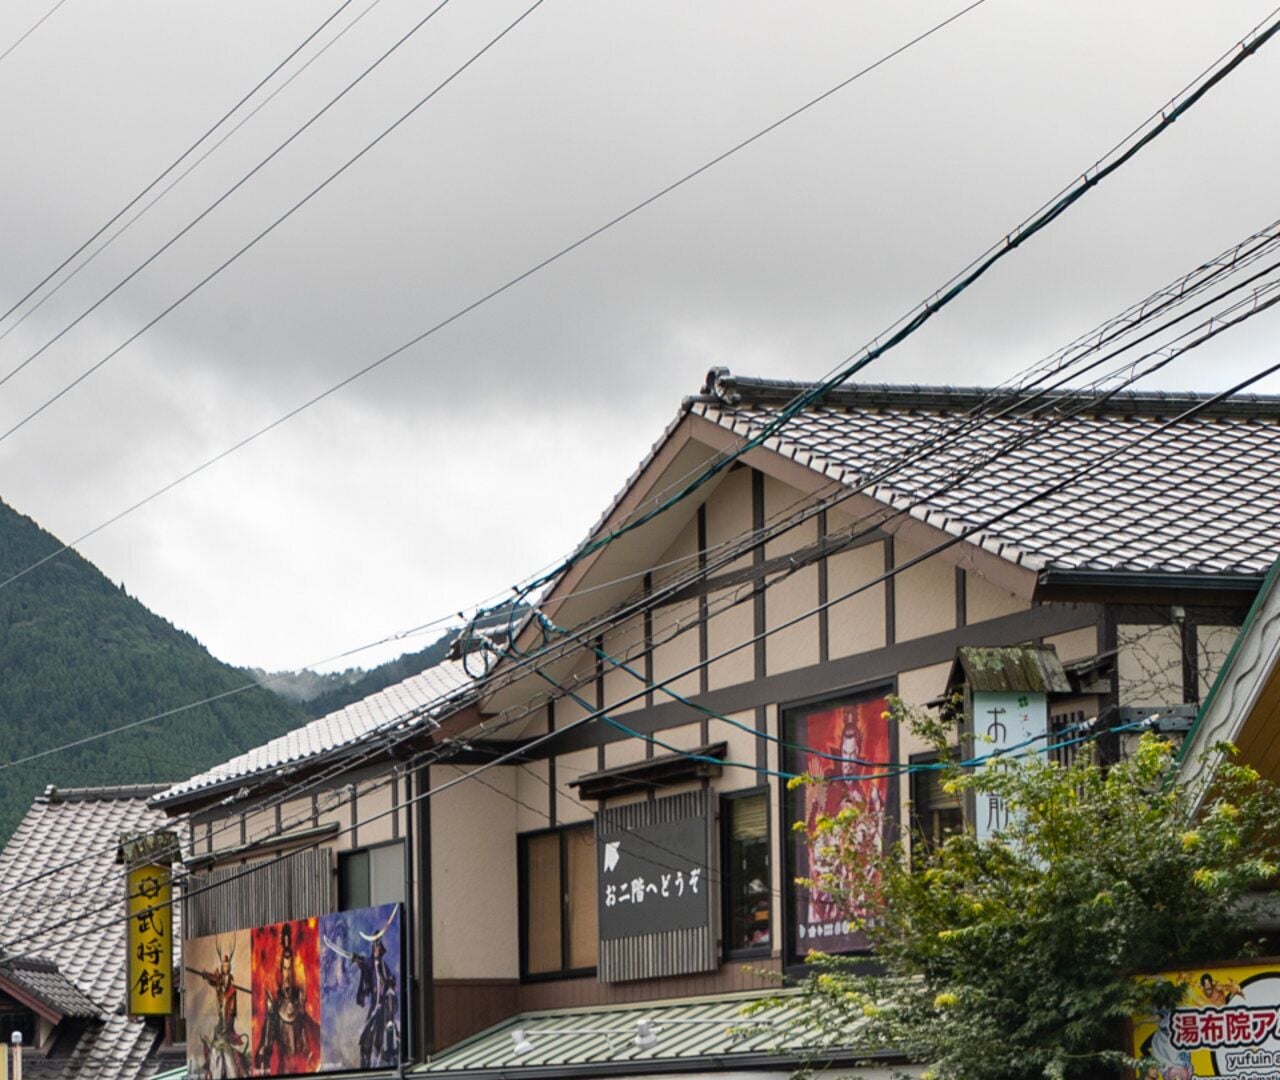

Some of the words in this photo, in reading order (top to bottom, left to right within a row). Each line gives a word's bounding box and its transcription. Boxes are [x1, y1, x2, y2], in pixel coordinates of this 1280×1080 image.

[605, 868, 701, 907] お二階へどうぞ
[1174, 1012, 1280, 1044] 湯布院ア
[1226, 1053, 1272, 1070] yufuin
